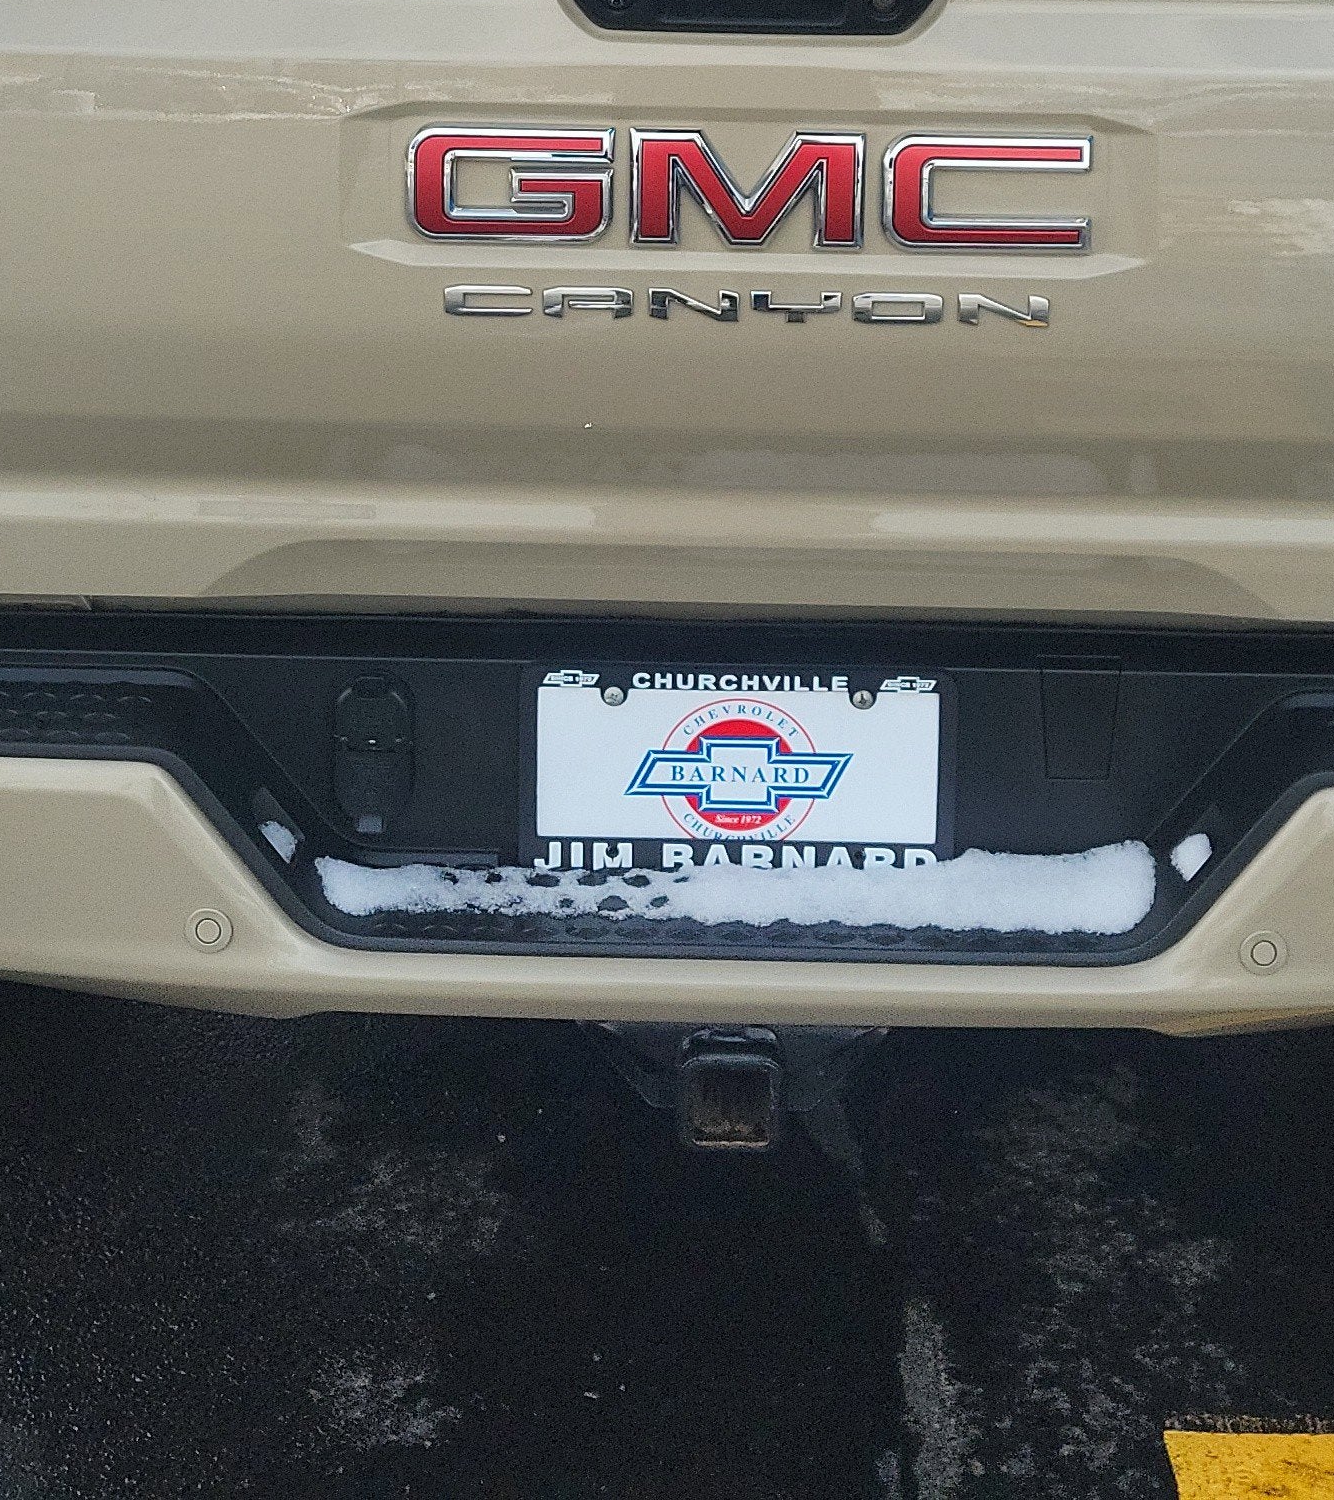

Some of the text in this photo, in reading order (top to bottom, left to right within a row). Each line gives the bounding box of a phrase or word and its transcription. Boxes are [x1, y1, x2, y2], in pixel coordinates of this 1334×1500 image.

[406, 126, 1093, 253] GMC
[441, 284, 1052, 328] CANYON
[631, 672, 849, 692] CHURCHVILLE
[683, 704, 799, 738] CHEVROLET
[671, 765, 810, 784] BARNARD
[715, 813, 762, 825] Since 1972
[534, 841, 937, 870] JIM BARNARD
